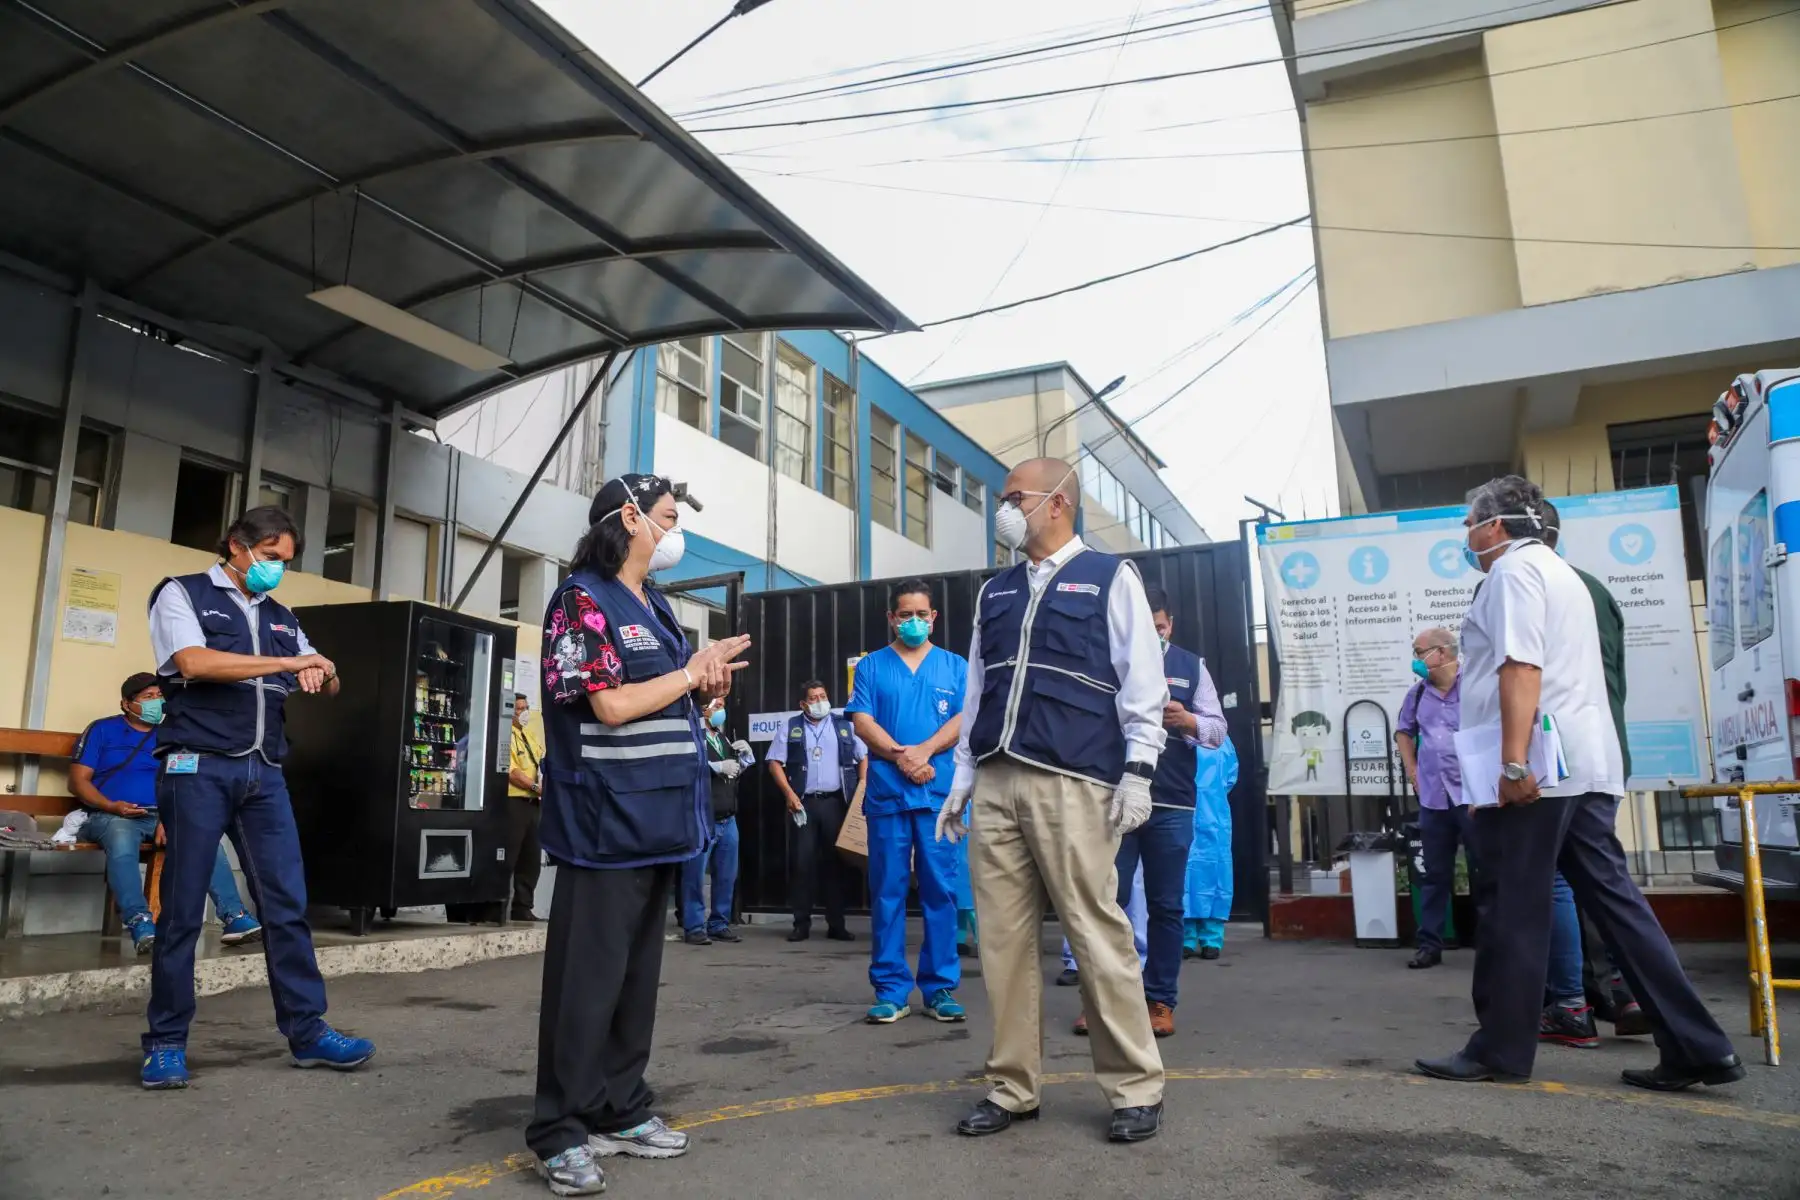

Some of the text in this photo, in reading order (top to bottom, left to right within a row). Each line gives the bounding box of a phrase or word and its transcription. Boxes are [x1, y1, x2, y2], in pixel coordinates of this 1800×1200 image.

[1608, 572, 1665, 584] Protección
[1425, 587, 1466, 597] Derecho
[1630, 586, 1644, 595] de
[1281, 595, 1327, 606] Derecho al
[1347, 591, 1397, 602] Derecho al
[1348, 605, 1380, 614] Acceso
[1389, 602, 1398, 611] la
[1430, 598, 1473, 609] Atención
[1615, 598, 1665, 608] Derechos
[1280, 609, 1309, 617] Acceso
[1317, 607, 1330, 616] los
[1281, 619, 1332, 628] Servicios de
[1345, 615, 1402, 625] Información
[1292, 632, 1318, 640] Salud
[1717, 700, 1778, 748] AMBUANCIA
[1346, 776, 1397, 784] ERVICIO
